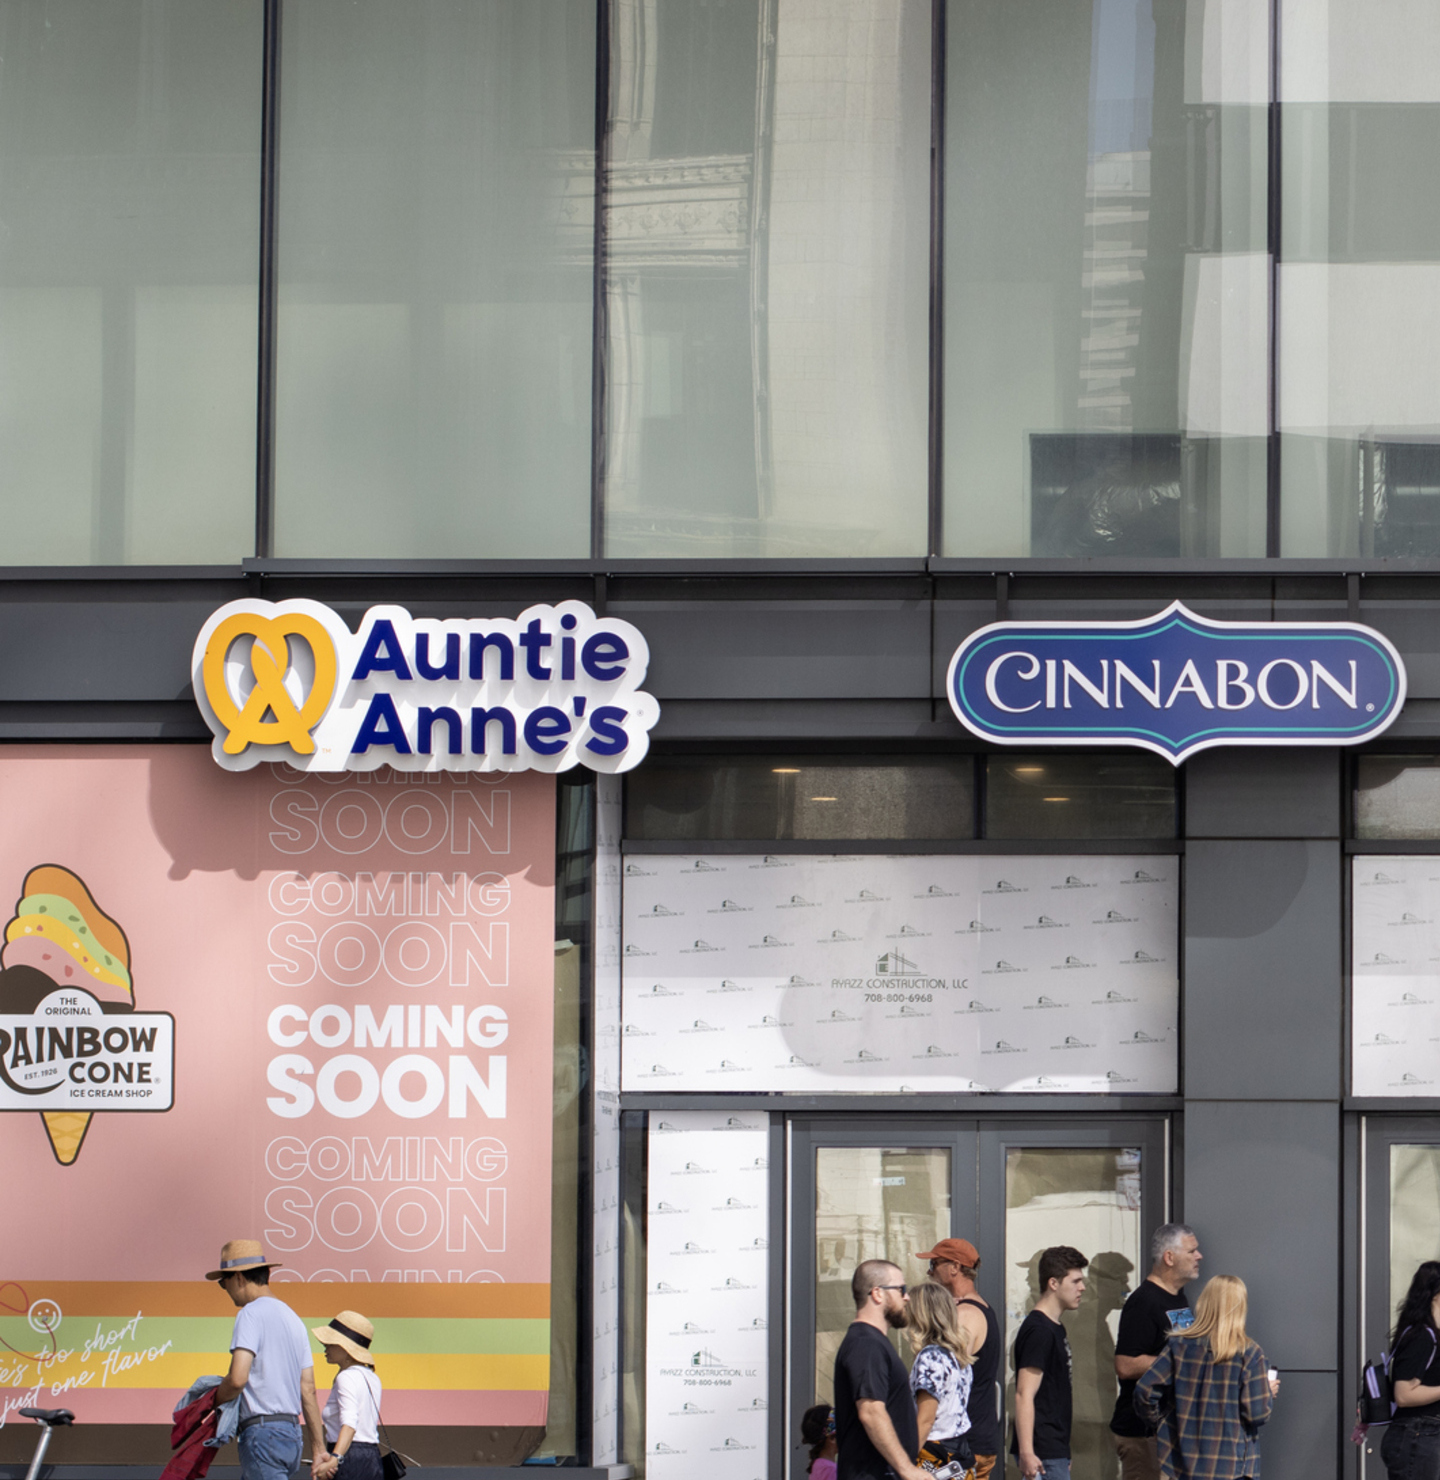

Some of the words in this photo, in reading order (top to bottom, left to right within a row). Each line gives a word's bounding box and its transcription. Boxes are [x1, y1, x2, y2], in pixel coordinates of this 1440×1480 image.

[351, 613, 629, 682] Auntie
[984, 651, 1358, 713] CINNABON
[351, 693, 630, 756] Anne's
[268, 788, 512, 855] SOON
[267, 871, 512, 916] COMING
[266, 920, 510, 986] SOON
[59, 997, 78, 1006] THE
[864, 993, 933, 1002] 708-800-6968
[866, 979, 949, 990] CONSTRUCTION,
[952, 979, 969, 989] LLC
[45, 1007, 92, 1016] ORIGINAL
[266, 1004, 509, 1048] COMING
[68, 1061, 152, 1084] CONE
[70, 1089, 86, 1098] ICE
[88, 1089, 123, 1098] CREAM
[126, 1089, 153, 1098] SHOP
[265, 1053, 508, 1120] SOON
[264, 1136, 508, 1182] COMING
[264, 1186, 507, 1253] SOON
[35, 1344, 74, 1375] too
[80, 1310, 144, 1363] short
[51, 1370, 95, 1397] one
[101, 1339, 173, 1388] flavor
